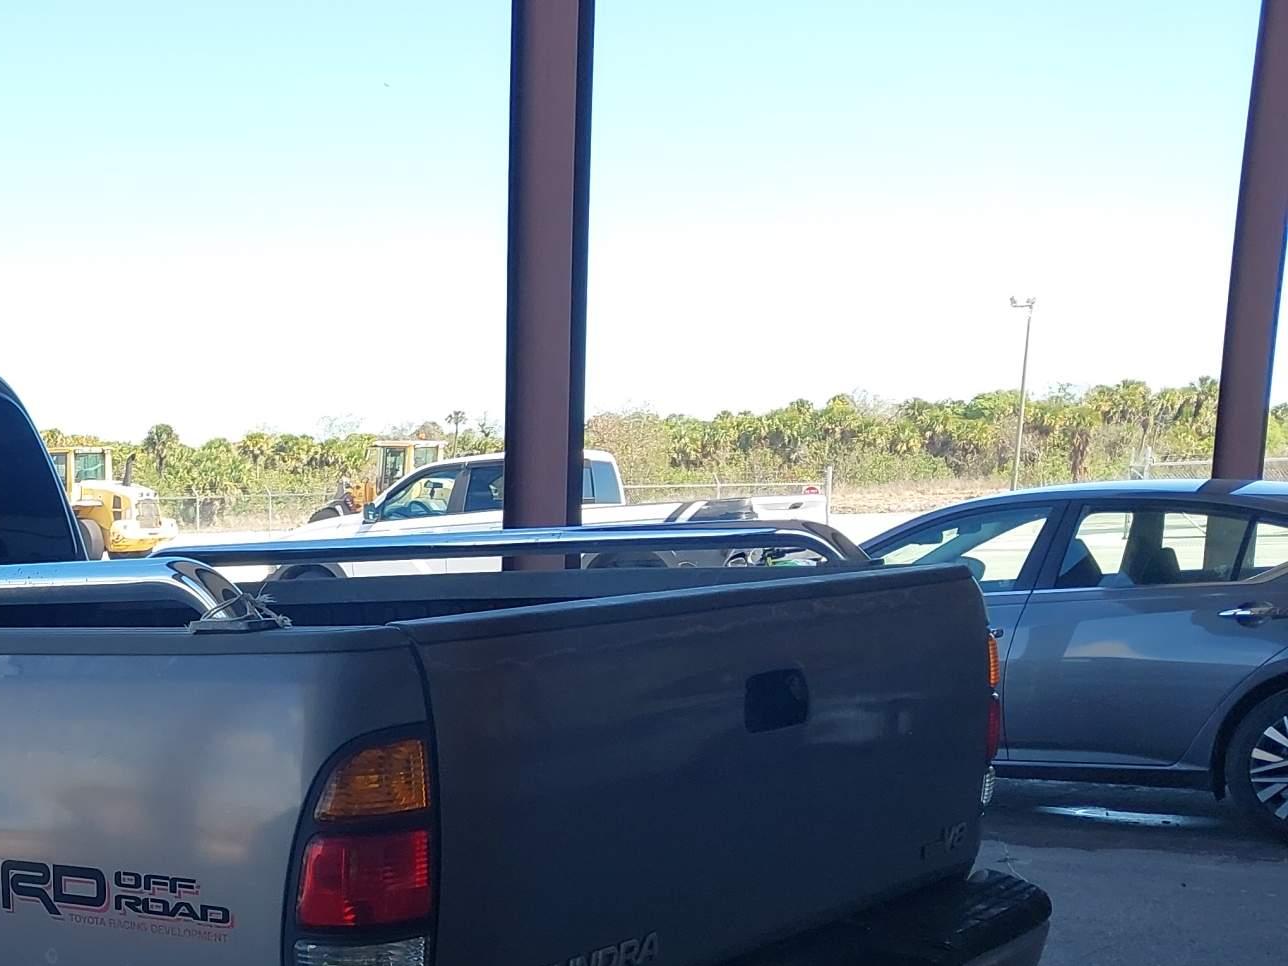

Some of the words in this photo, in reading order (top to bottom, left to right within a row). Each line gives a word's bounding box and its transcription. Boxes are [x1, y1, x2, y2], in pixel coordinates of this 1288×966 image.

[942, 822, 968, 852] V8
[114, 870, 200, 895] OFF
[114, 894, 233, 927] ROAD
[69, 912, 107, 927] TOYOTA
[109, 919, 148, 933] RACING
[150, 924, 228, 944] DEVELOPMENT
